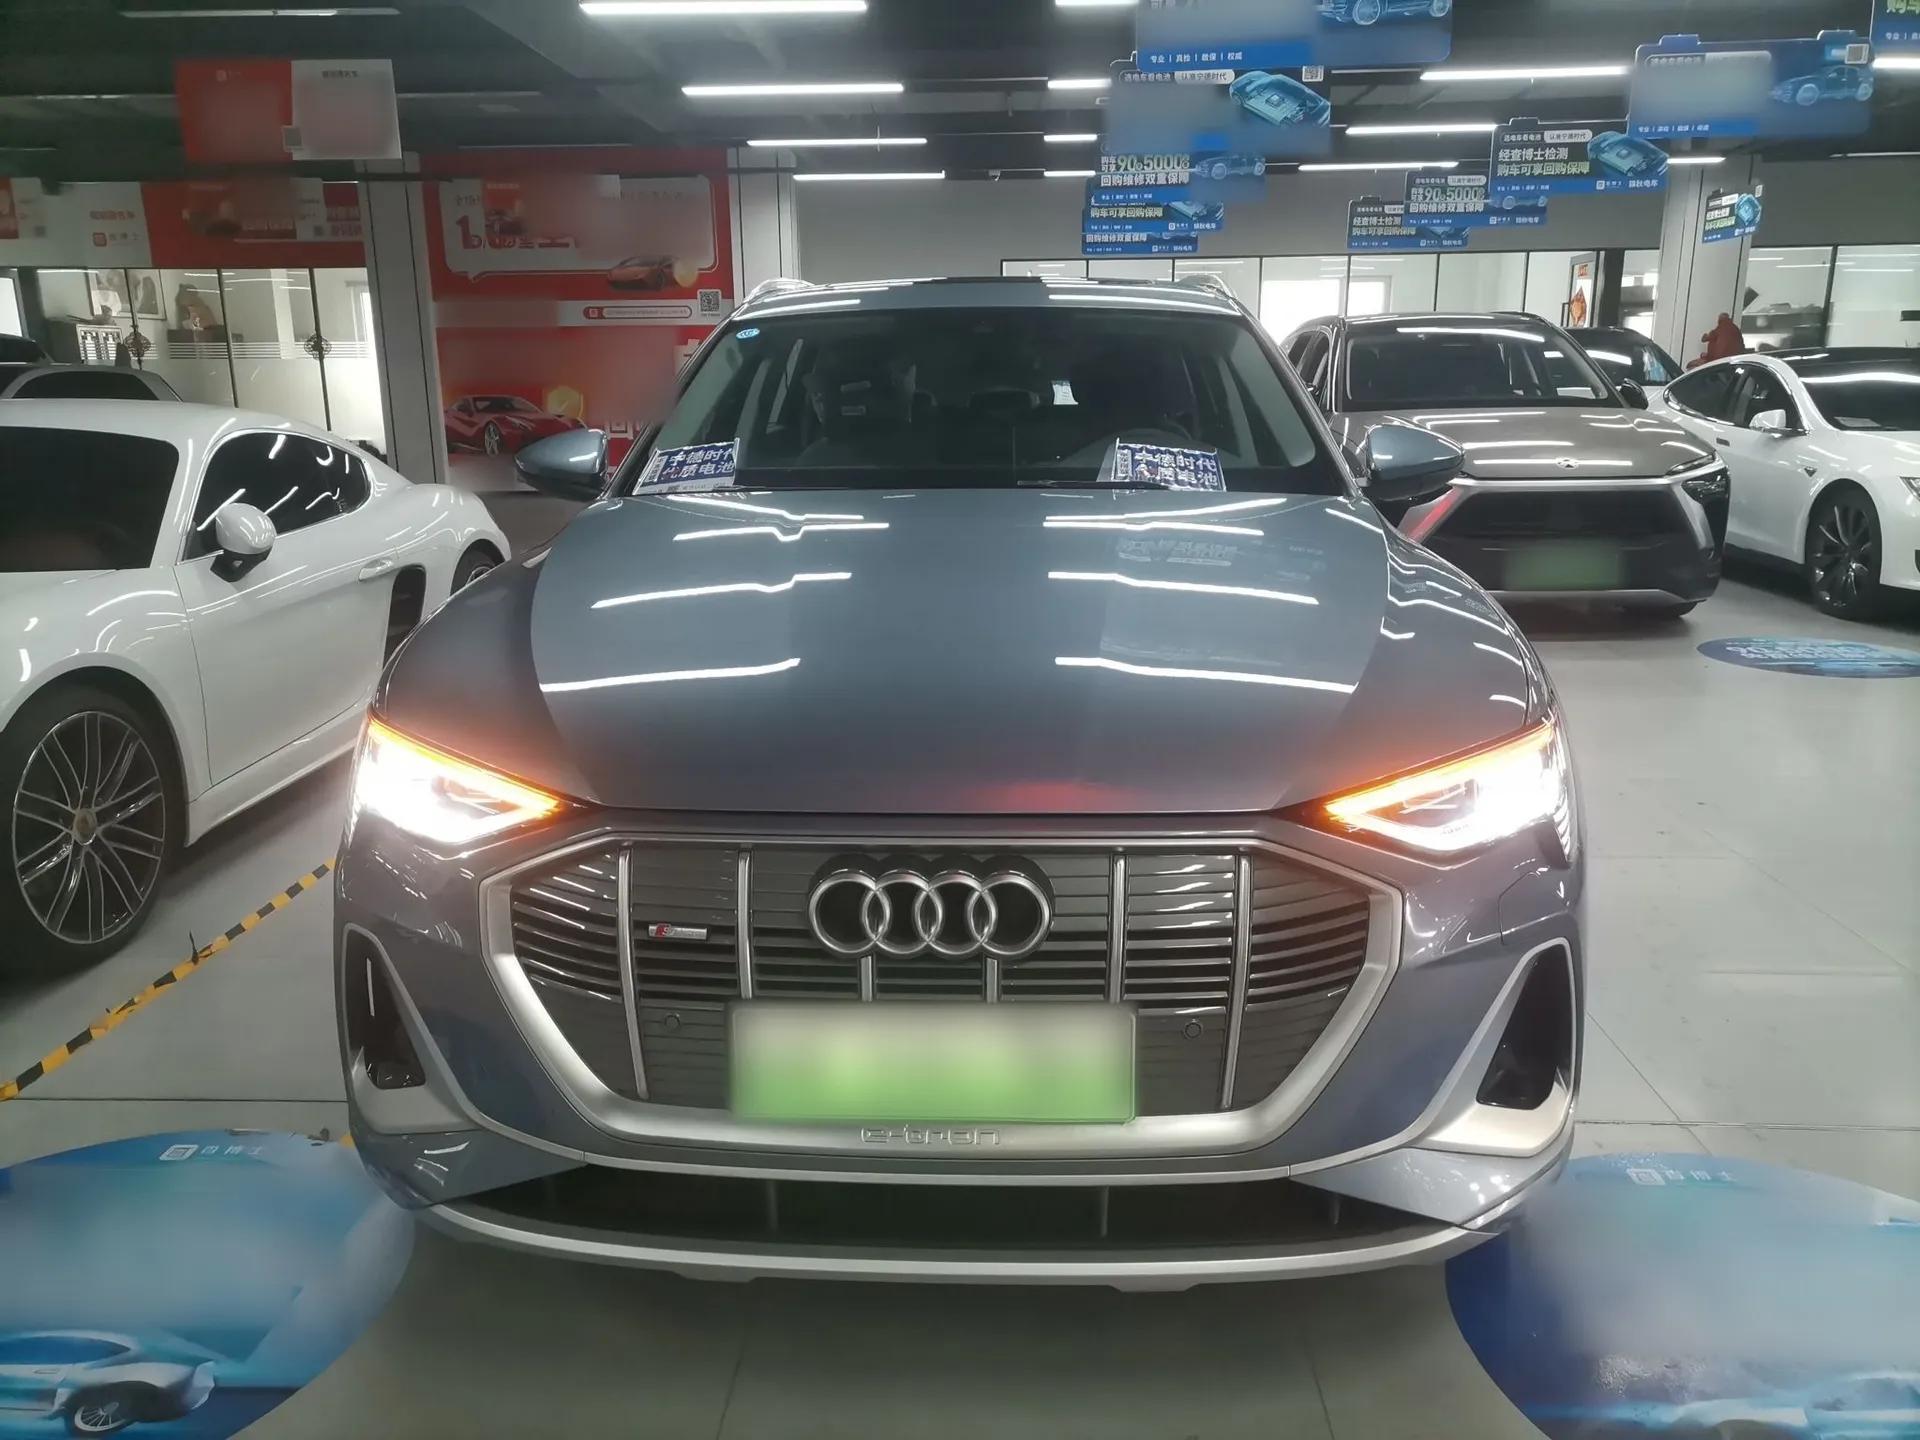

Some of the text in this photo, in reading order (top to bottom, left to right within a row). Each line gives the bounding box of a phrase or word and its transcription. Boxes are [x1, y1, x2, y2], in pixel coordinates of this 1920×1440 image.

[1150, 55, 1165, 64] 专业
[1498, 147, 1569, 162] 经查博士检测
[1497, 161, 1590, 177] 购车可享回购保障
[1100, 172, 1190, 187] 回购维修双重保障
[1090, 207, 1163, 218] 购车可享回购保障
